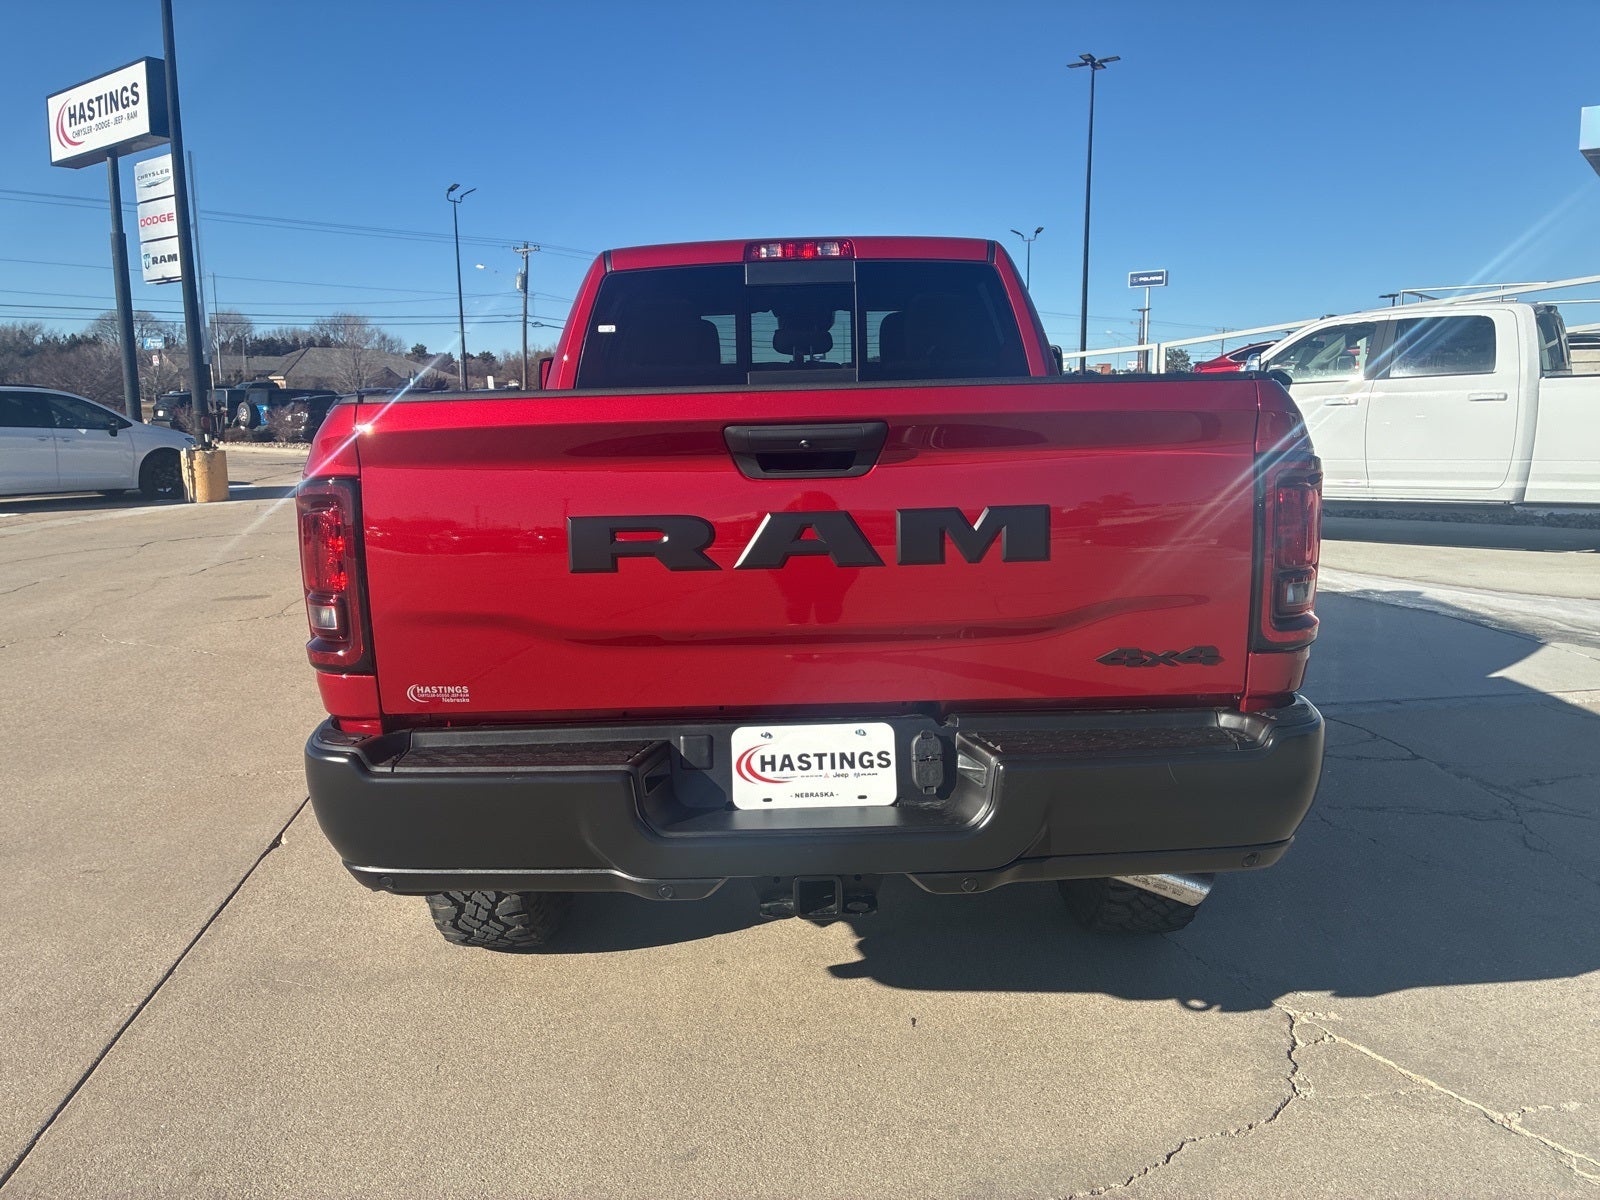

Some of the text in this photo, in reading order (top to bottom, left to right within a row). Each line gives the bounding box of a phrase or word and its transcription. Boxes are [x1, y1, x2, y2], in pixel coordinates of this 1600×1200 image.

[68, 82, 140, 128] HASTINGS
[72, 110, 138, 139] CHRYSLER DODGE JEEP RAM
[137, 168, 170, 181] CHRYSLER
[140, 212, 174, 228] DODGE
[152, 253, 178, 265] RAM
[567, 504, 1051, 574] RAM
[760, 751, 891, 772] HASTINGS
